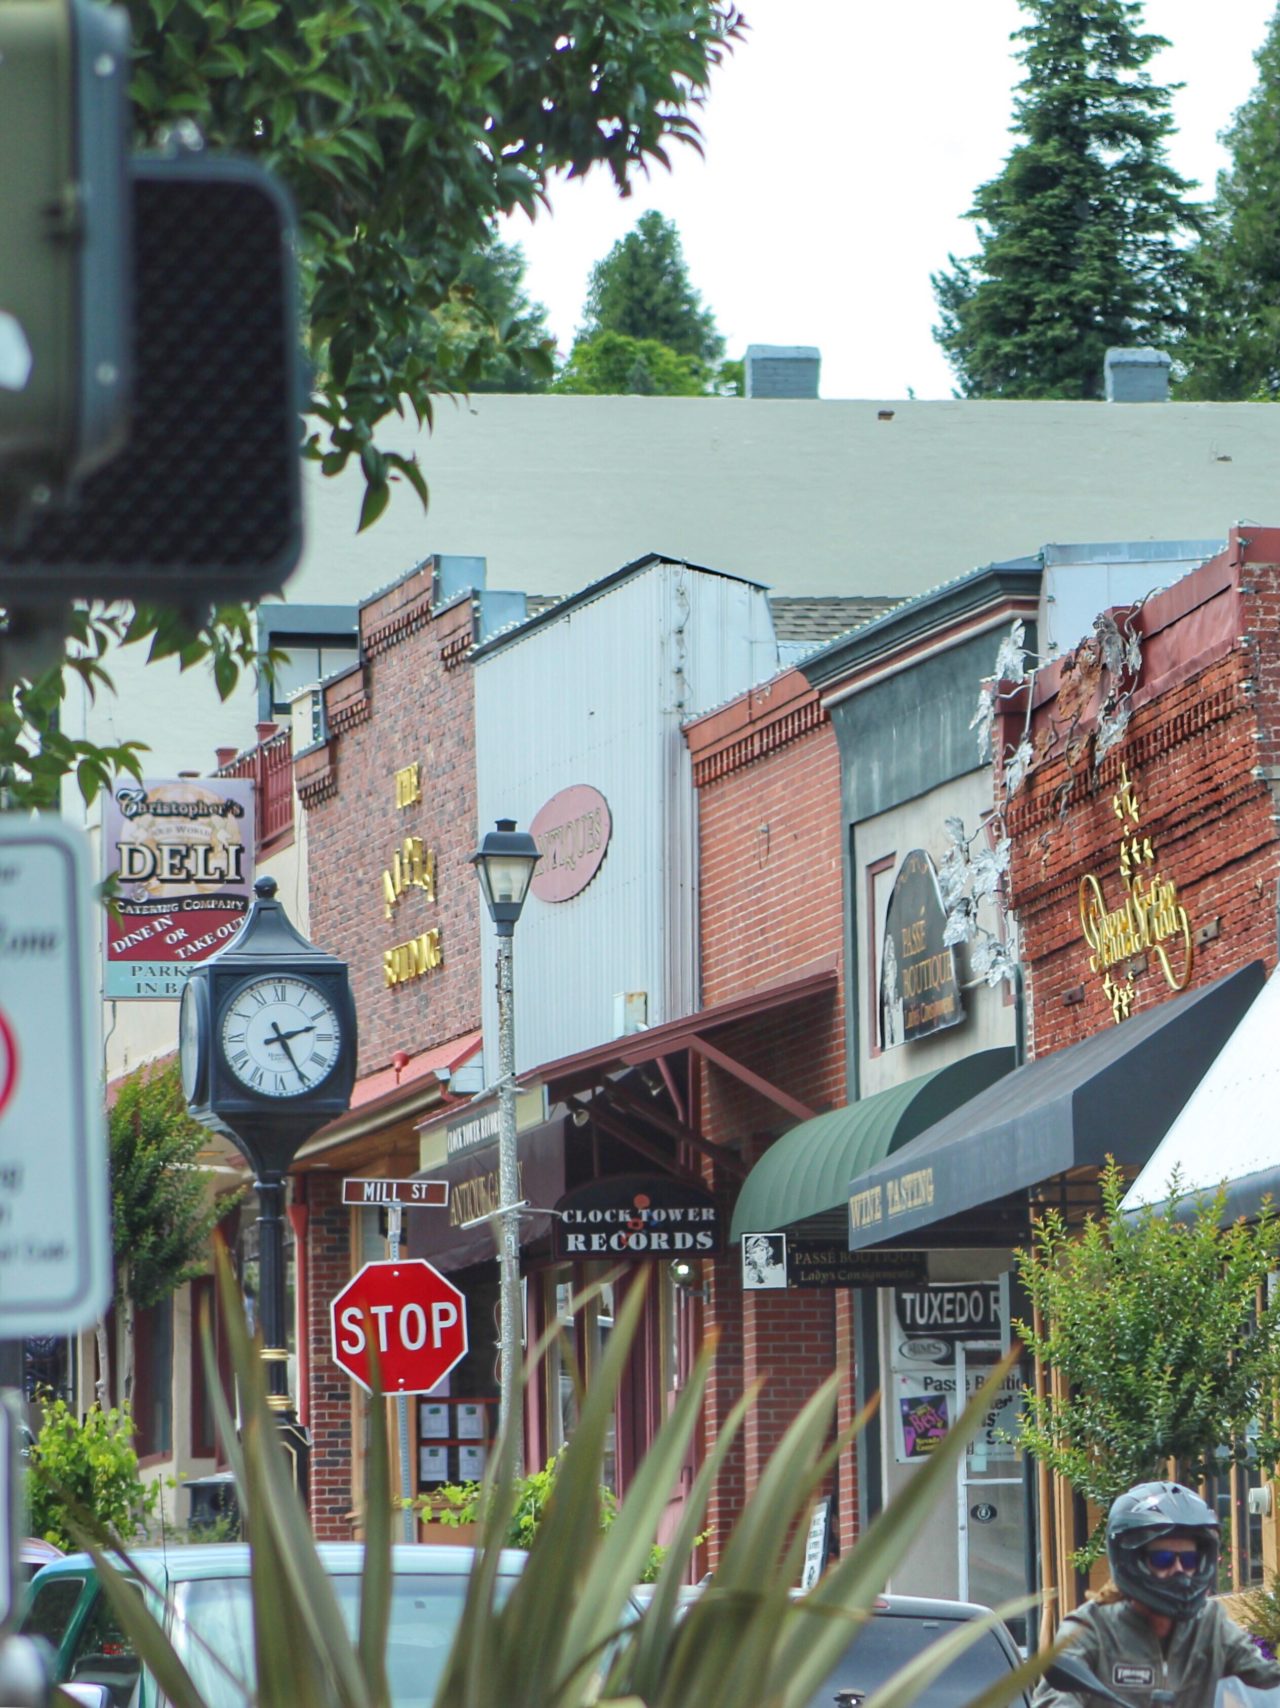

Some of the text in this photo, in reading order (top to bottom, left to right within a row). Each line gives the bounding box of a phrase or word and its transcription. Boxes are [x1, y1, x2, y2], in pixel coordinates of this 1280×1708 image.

[116, 788, 245, 819] Christopher's
[175, 825, 211, 837] WORLD
[117, 842, 245, 884] DELI
[117, 899, 245, 915] CATERING COMPANY
[111, 914, 176, 954] DINE IN
[164, 927, 190, 945] OR
[174, 915, 247, 960] TAKE OUT
[136, 982, 158, 994] IN
[362, 1182, 429, 1202] MILL ST
[850, 1167, 935, 1230] WINE TASTING
[561, 1207, 716, 1224] CLOCK TOWER
[565, 1229, 714, 1252] RECORDS
[901, 1290, 984, 1325] TUXEDO
[340, 1301, 458, 1355] STOP
